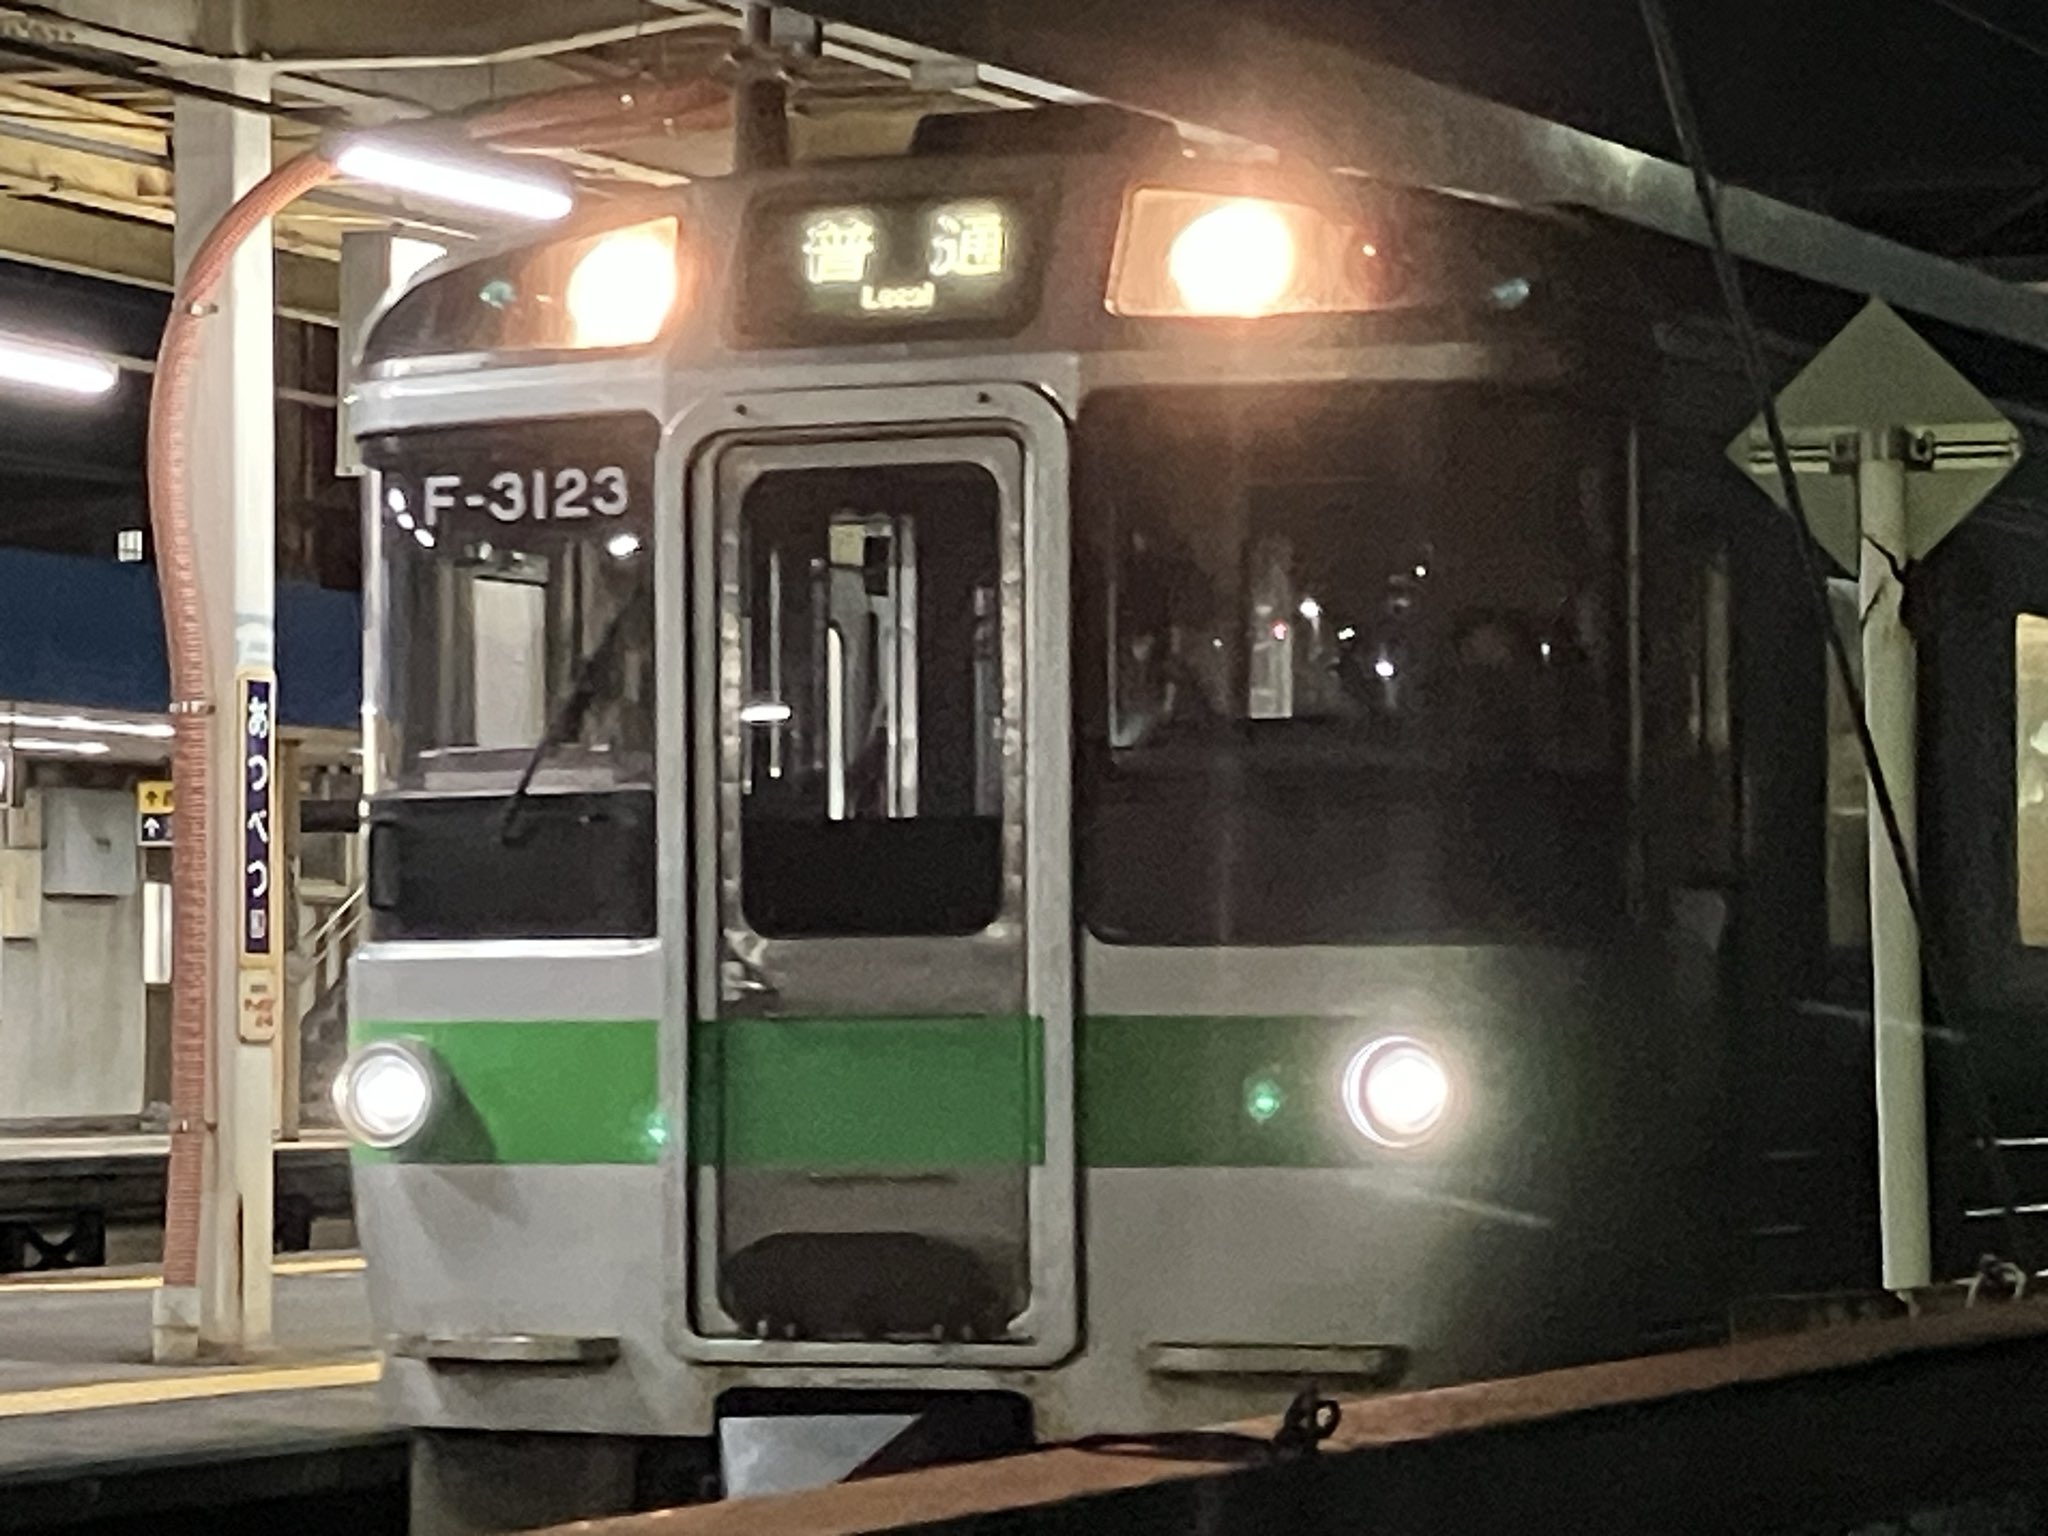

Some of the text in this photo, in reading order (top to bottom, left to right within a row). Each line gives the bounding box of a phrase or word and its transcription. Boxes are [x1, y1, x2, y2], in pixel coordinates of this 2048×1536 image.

[861, 281, 935, 309] Local
[424, 466, 629, 526] F-3123
[247, 696, 269, 897] あつべつ
